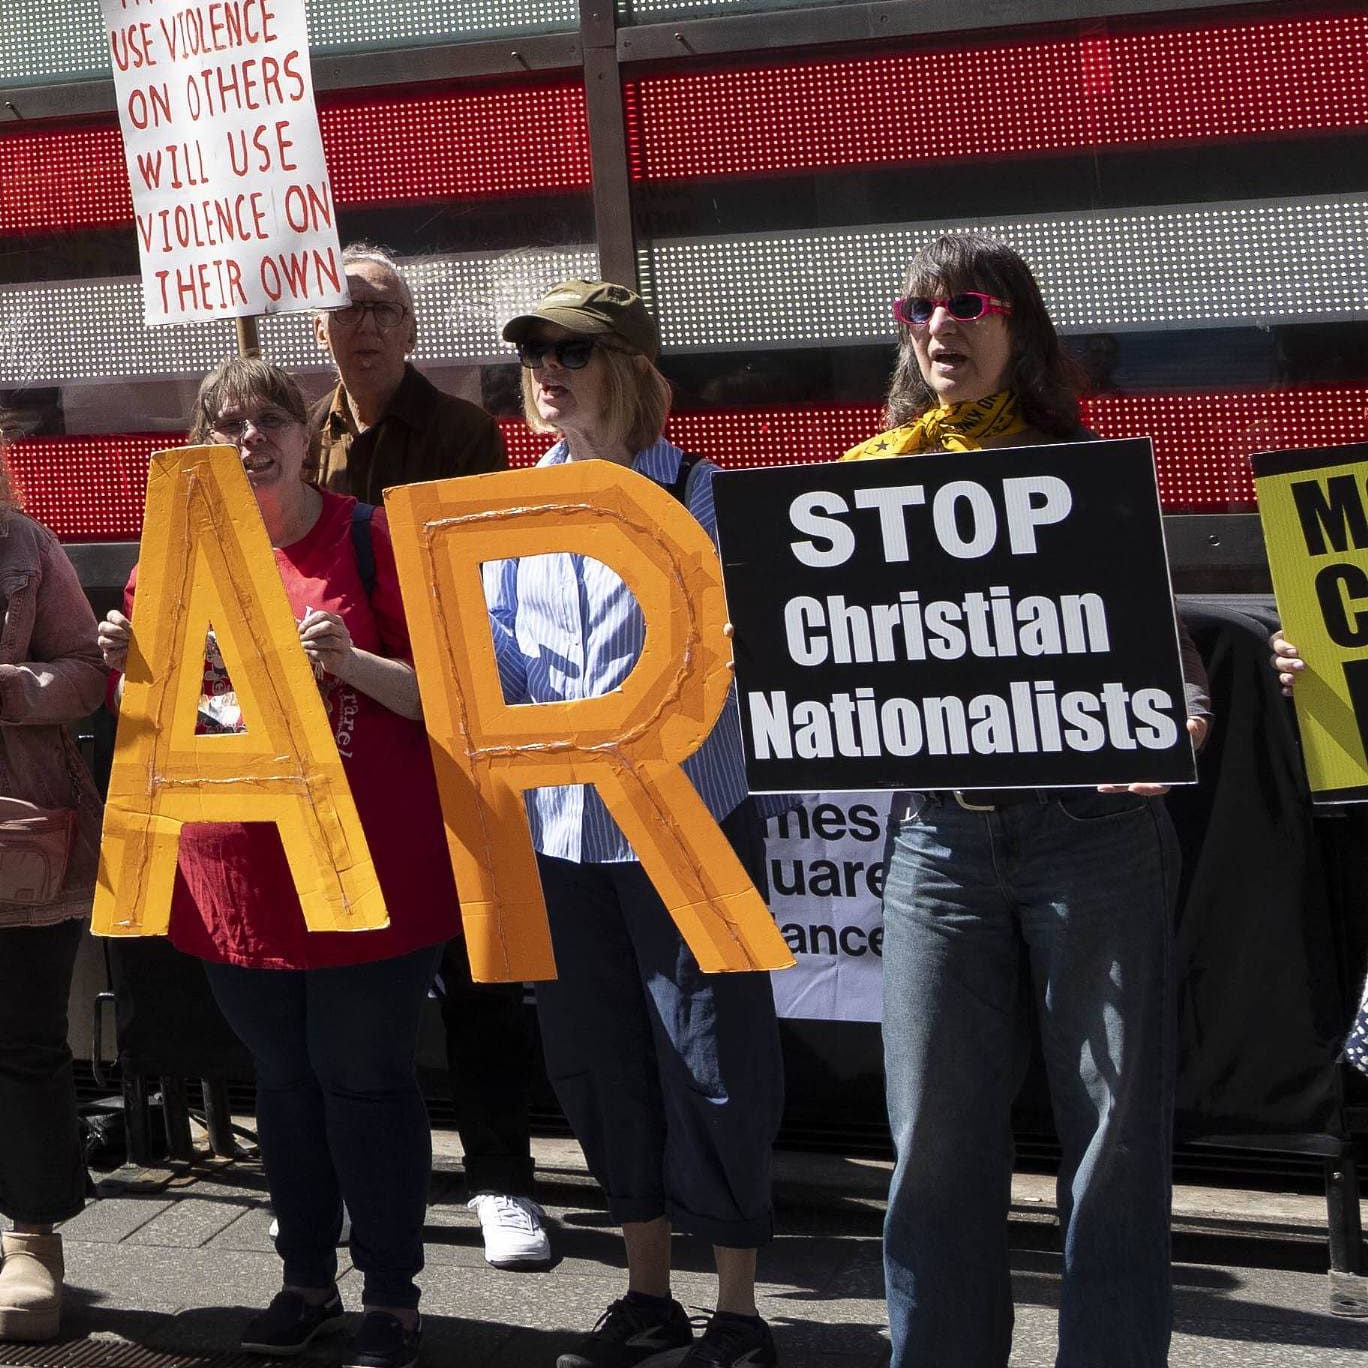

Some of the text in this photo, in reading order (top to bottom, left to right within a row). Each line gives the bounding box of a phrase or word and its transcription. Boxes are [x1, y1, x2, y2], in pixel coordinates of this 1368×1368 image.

[111, 22, 156, 72] USE
[128, 49, 305, 130] ON OTHERS
[137, 120, 298, 190] WILL USE
[138, 182, 332, 254] VIOLENCE ON
[155, 246, 341, 315] THEIR OWN
[788, 474, 1074, 569] STOP
[783, 584, 1112, 668] Christian
[747, 679, 1179, 761] Nationalists
